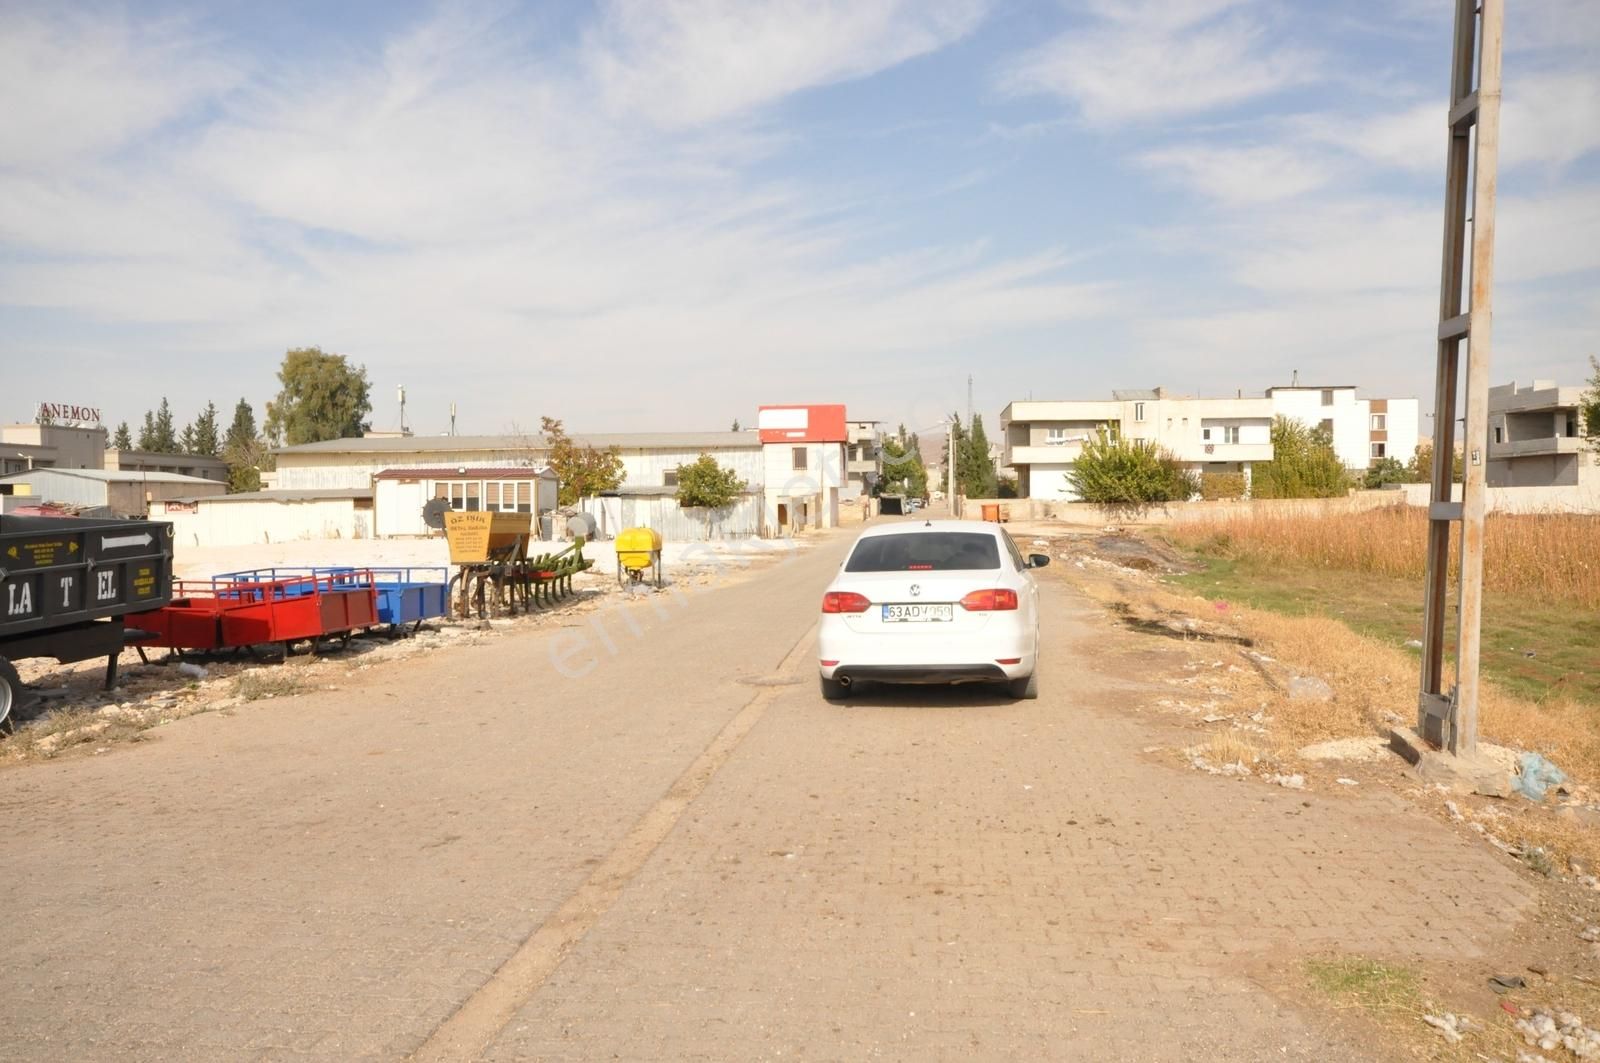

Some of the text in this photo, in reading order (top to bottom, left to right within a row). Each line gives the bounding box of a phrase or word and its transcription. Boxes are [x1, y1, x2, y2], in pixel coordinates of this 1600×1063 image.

[41, 402, 101, 422] ANEMON
[8, 570, 117, 615] LA T EL
